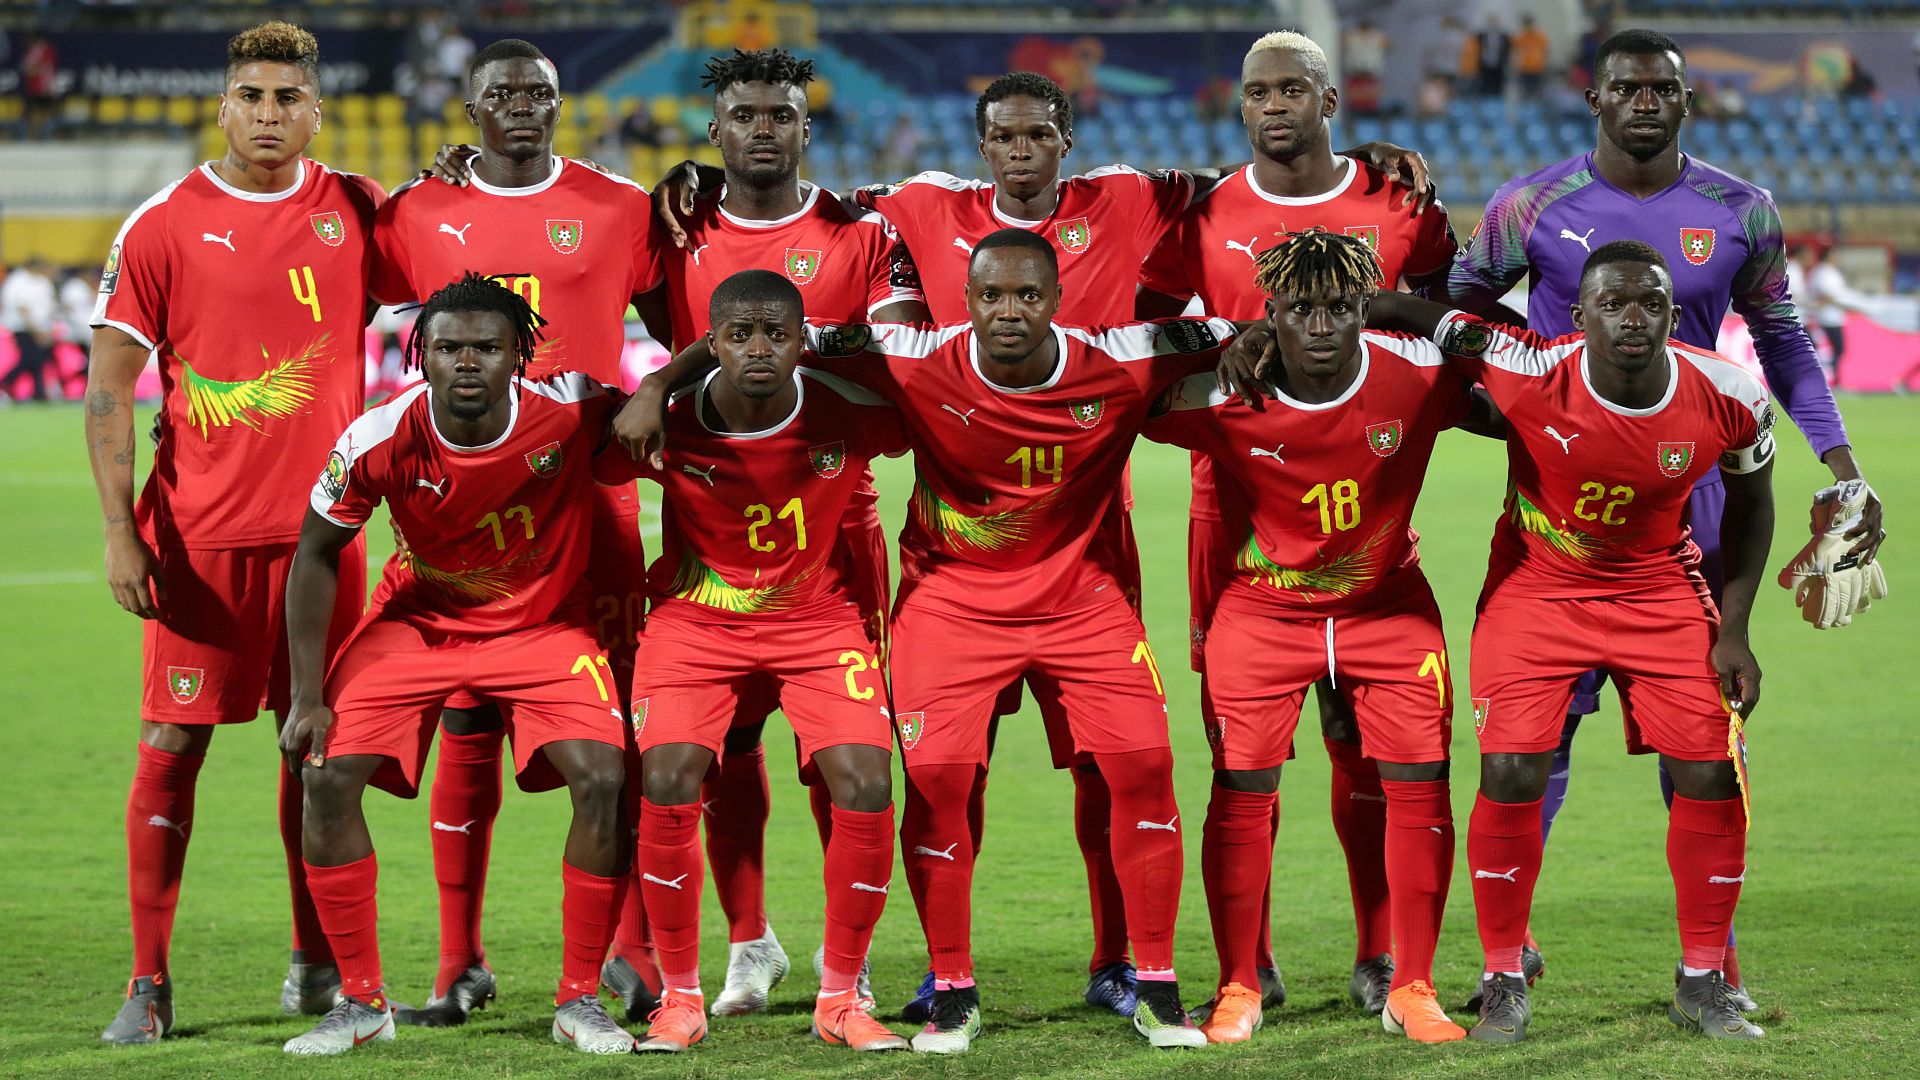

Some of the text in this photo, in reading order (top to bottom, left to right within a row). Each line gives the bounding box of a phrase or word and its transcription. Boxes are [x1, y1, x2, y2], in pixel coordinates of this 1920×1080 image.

[288, 266, 322, 322] 4
[491, 275, 541, 332] 0
[1005, 445, 1065, 488] 14
[475, 504, 535, 552] 17
[743, 497, 808, 553] 21
[1301, 479, 1361, 535] 18
[1573, 481, 1635, 526] 22
[595, 591, 640, 649] 20
[837, 650, 880, 701] 2
[1131, 640, 1163, 696] 1
[1417, 649, 1452, 709] 1
